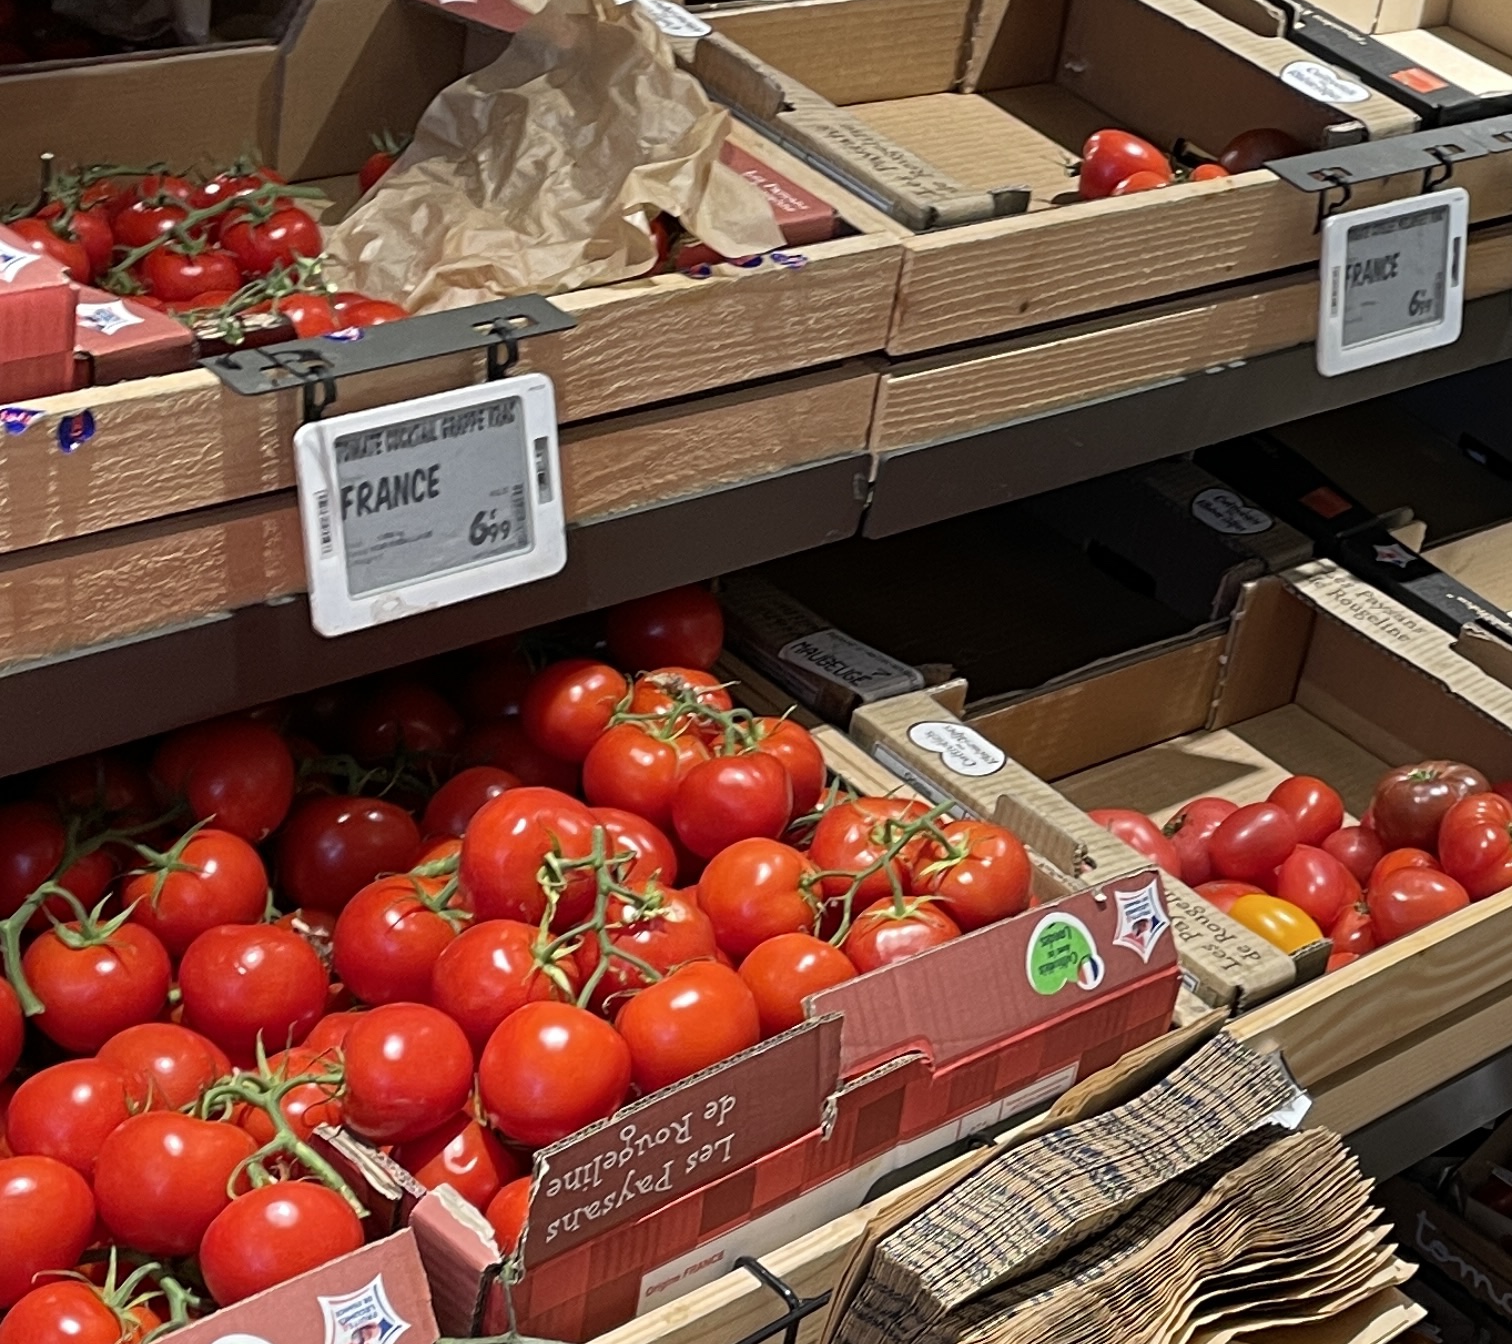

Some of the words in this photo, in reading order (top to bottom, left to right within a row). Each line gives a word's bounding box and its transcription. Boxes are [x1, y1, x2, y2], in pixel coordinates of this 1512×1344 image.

[1345, 252, 1401, 291] FRANCE
[341, 463, 442, 521] FRANCE
[790, 640, 875, 687] MAUBEUGE
[1200, 943, 1243, 971] Les
[1236, 944, 1262, 962] de
[702, 1093, 738, 1126] de
[545, 1111, 698, 1199] Rougeline
[685, 1130, 736, 1177] Les
[545, 1159, 674, 1244] Paysans
